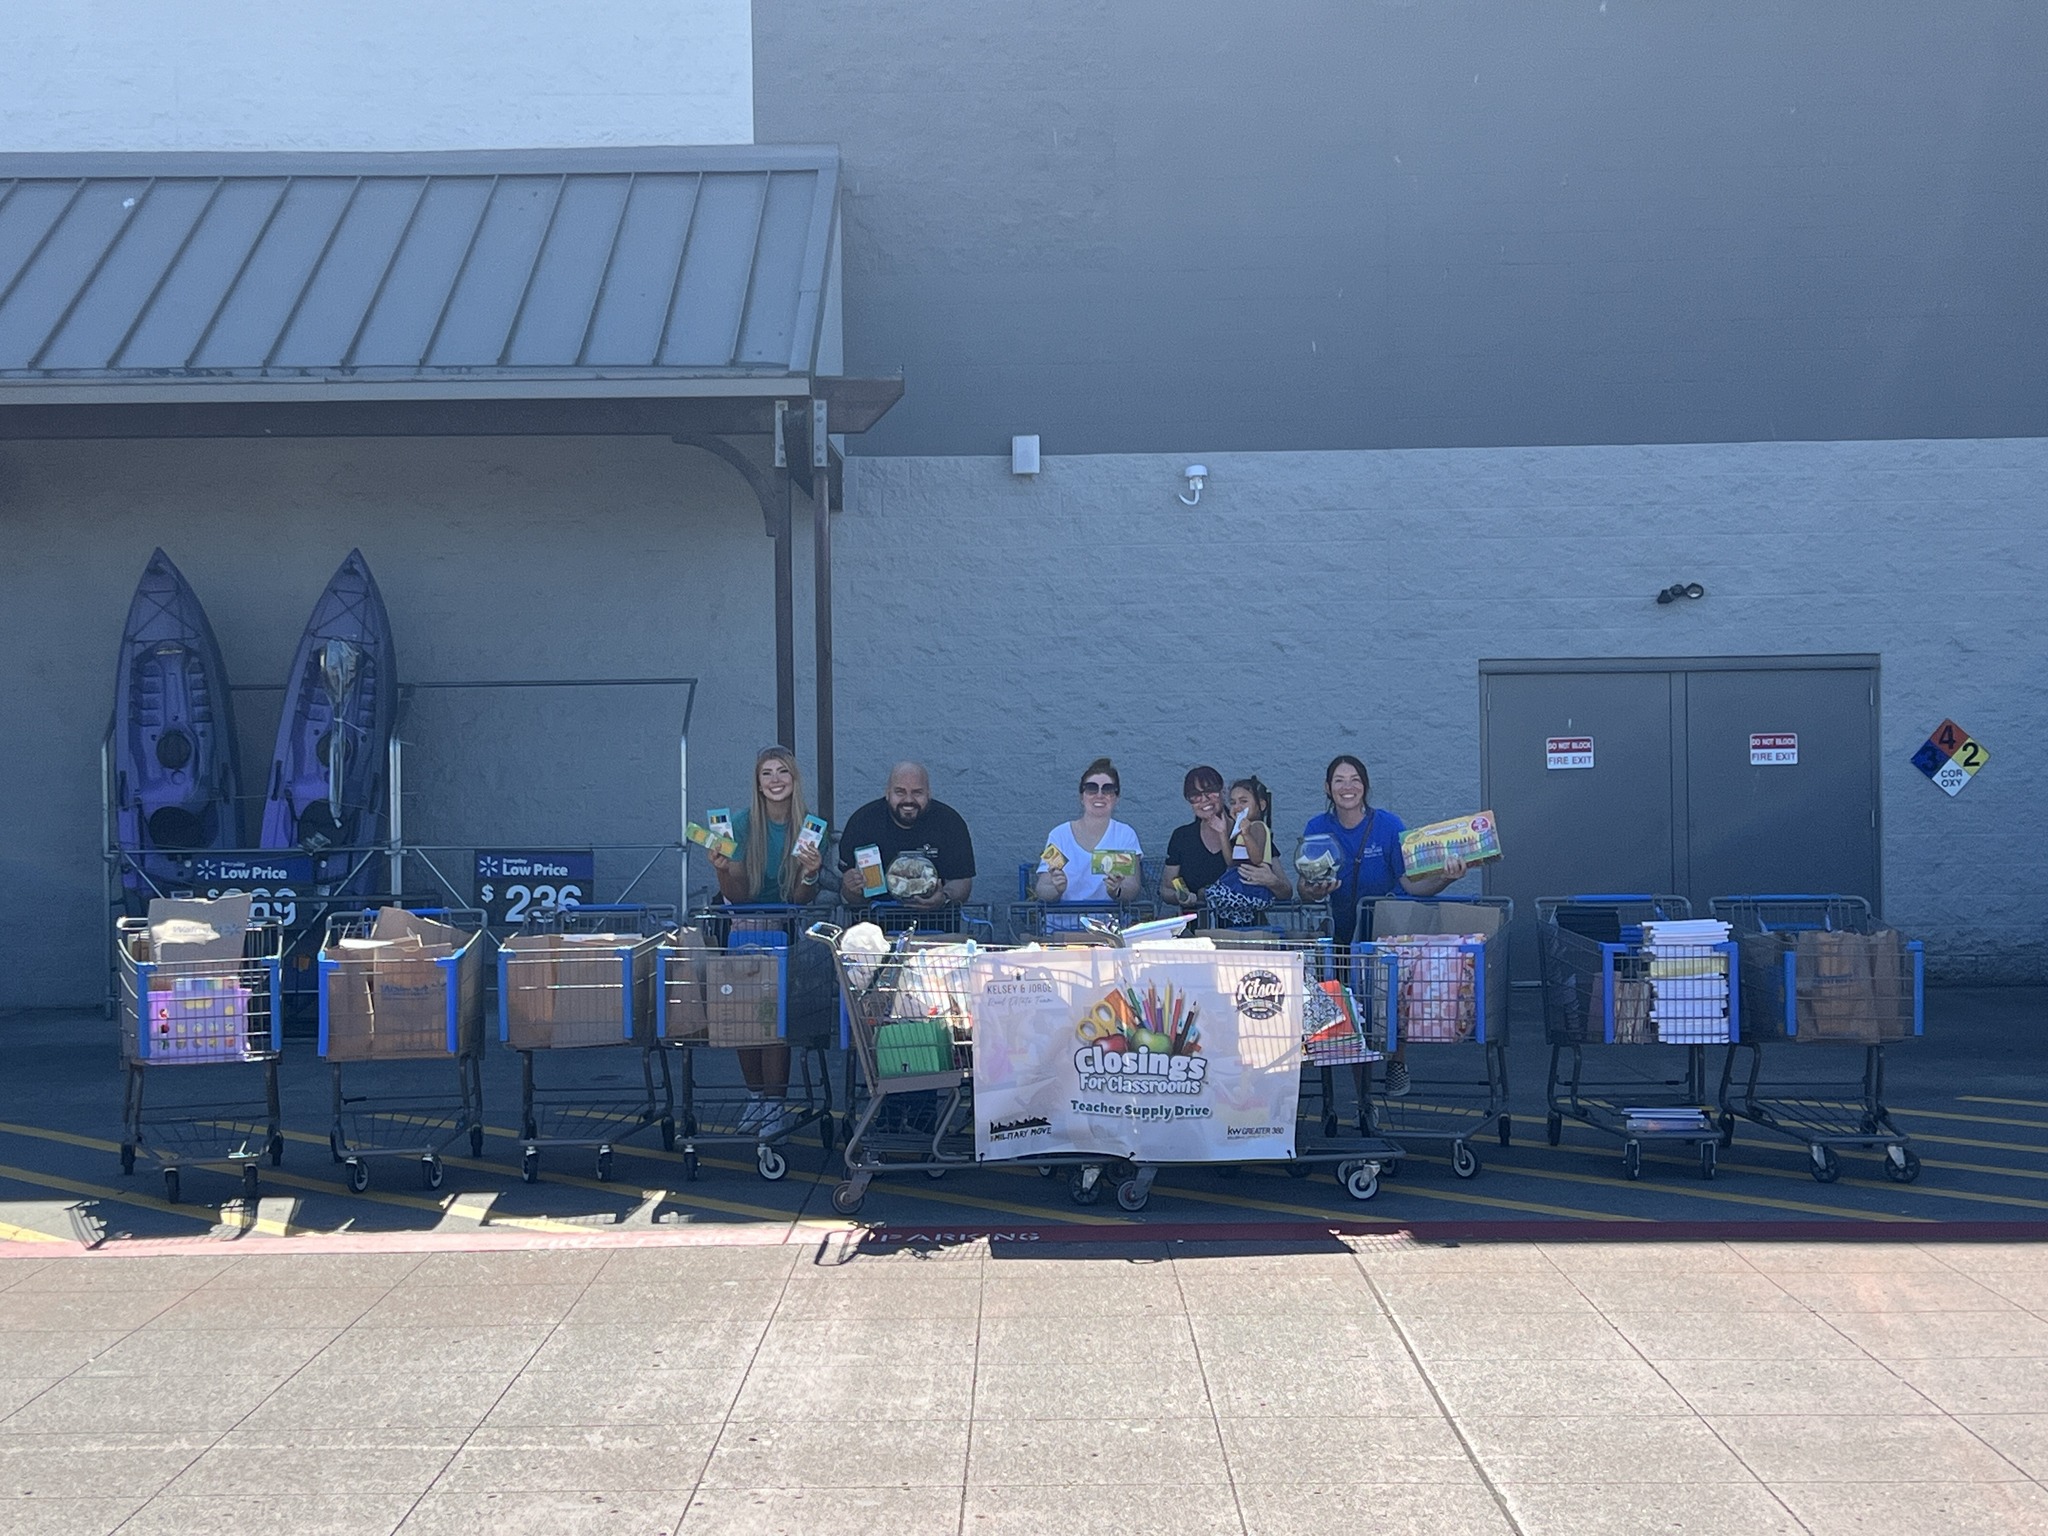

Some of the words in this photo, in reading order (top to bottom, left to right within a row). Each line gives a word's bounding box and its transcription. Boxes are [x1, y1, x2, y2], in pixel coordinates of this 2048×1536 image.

[1761, 738, 1774, 746] NOT
[1775, 737, 1795, 746] BLOCK
[1939, 725, 1956, 749] 4
[1548, 756, 1570, 765] FIRE
[1572, 755, 1592, 765] EXIT
[1752, 752, 1773, 761] FIRE
[1775, 752, 1796, 761] EXIT
[1921, 746, 1937, 772] 3
[1962, 742, 1980, 767] 2
[1941, 769, 1963, 778] COR
[1941, 779, 1963, 788] OXY
[220, 867, 250, 879] Low
[252, 866, 288, 879] Price
[502, 864, 532, 876] Low
[533, 863, 569, 877] Price
[987, 984, 1017, 995] KELSEY
[1020, 984, 1026, 994] &
[1028, 982, 1053, 993] JORGE
[1236, 977, 1284, 1003] Kitsap
[1074, 1045, 1207, 1081] Closings
[1080, 1073, 1106, 1091] For
[1107, 1076, 1201, 1094] Classrooms
[1071, 1100, 1122, 1114] Teacher
[1124, 1104, 1172, 1119] Supply
[1174, 1104, 1210, 1116] Drive
[994, 1130, 1028, 1141] MILITARY
[1031, 1126, 1051, 1136] MOVE
[881, 1232, 1039, 1242] PARKING
